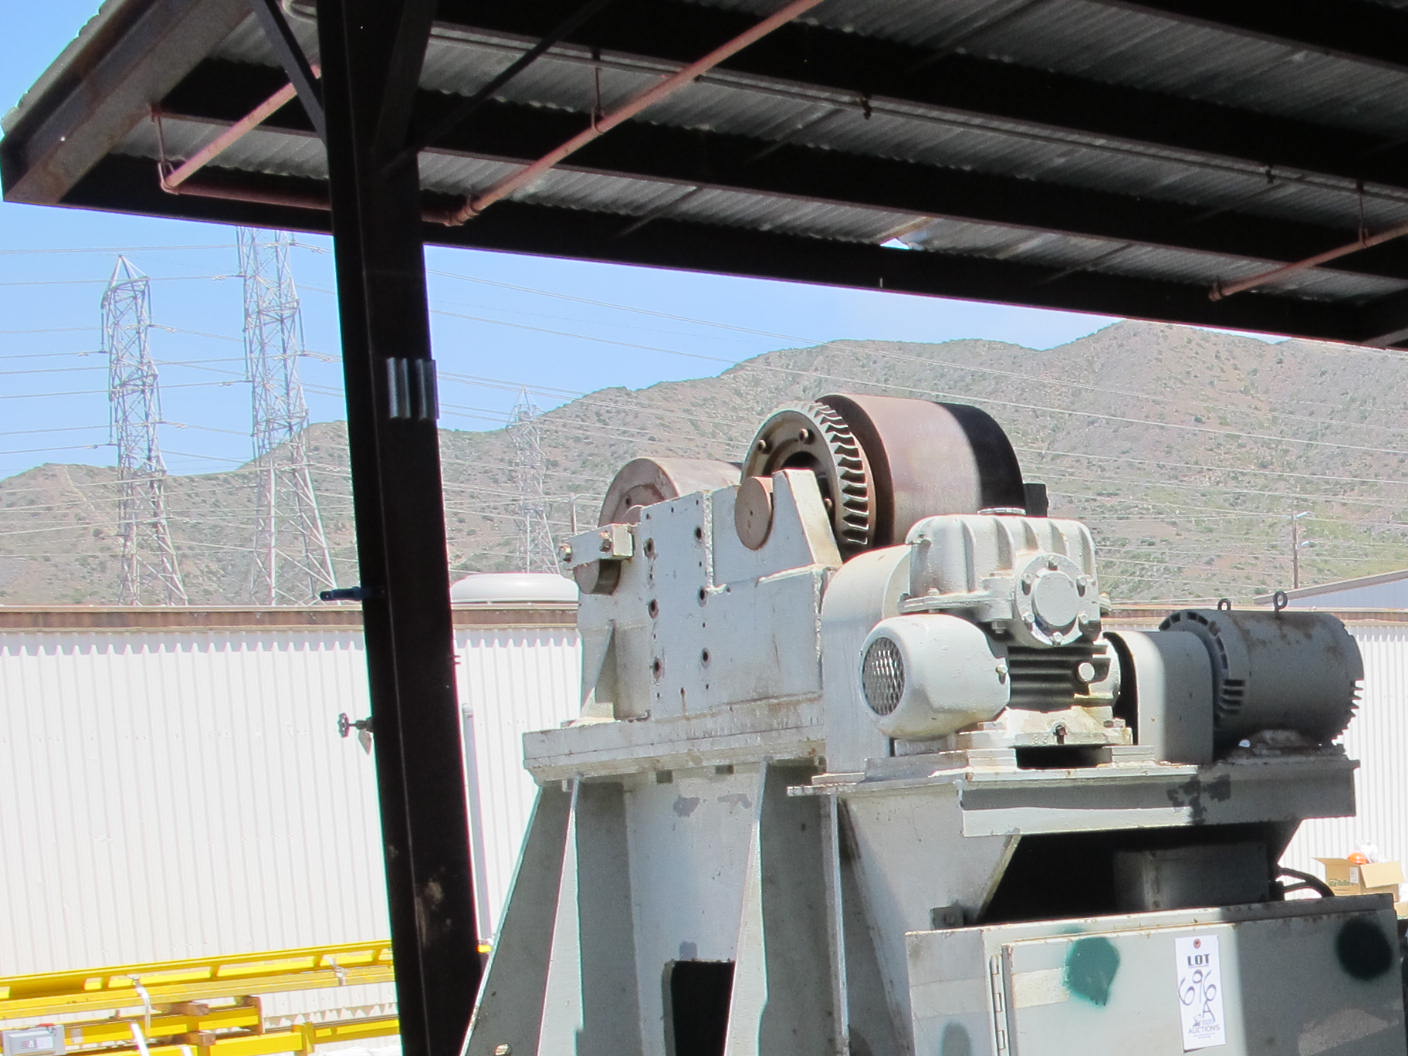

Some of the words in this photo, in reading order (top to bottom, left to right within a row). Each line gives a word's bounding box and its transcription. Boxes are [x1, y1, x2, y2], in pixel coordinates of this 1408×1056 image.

[1187, 953, 1210, 967] LOT
[1178, 969, 1217, 1007] 696
[1202, 1001, 1216, 1023] A
